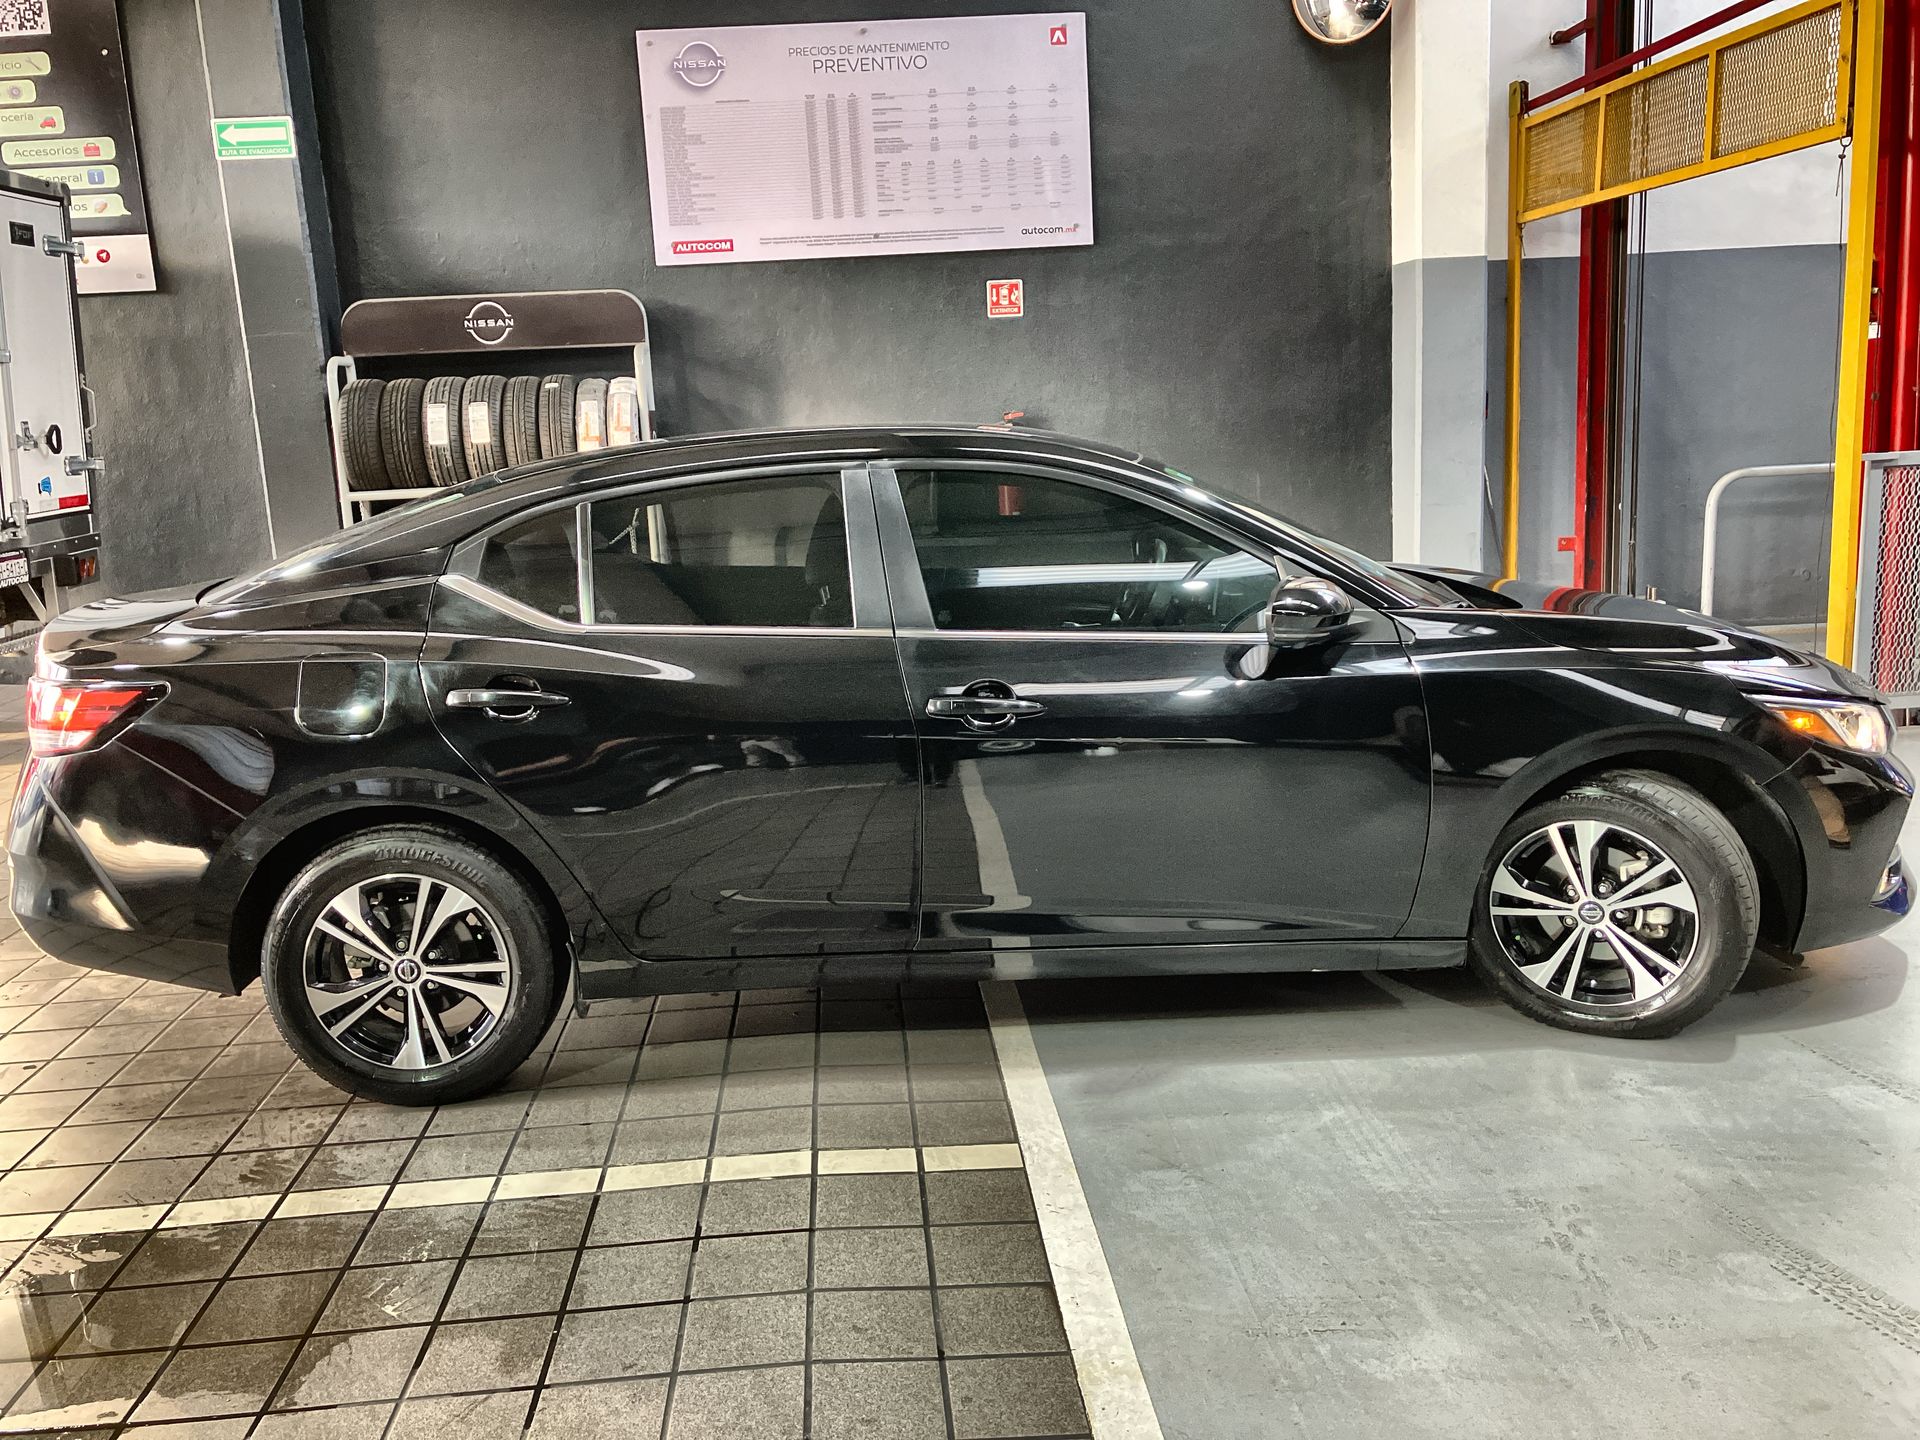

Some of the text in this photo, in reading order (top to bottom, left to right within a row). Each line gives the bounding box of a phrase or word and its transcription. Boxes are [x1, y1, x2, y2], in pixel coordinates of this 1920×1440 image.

[788, 41, 950, 57] PRECIOS DE MANTENIMIENTO
[673, 59, 727, 69] NISSAN
[813, 55, 928, 74] PREVENTIVO
[14, 146, 80, 158] Accesorios
[1020, 225, 1077, 235] autocom.mx
[676, 241, 731, 252] AUTOCOM
[464, 318, 514, 328] NISSAN
